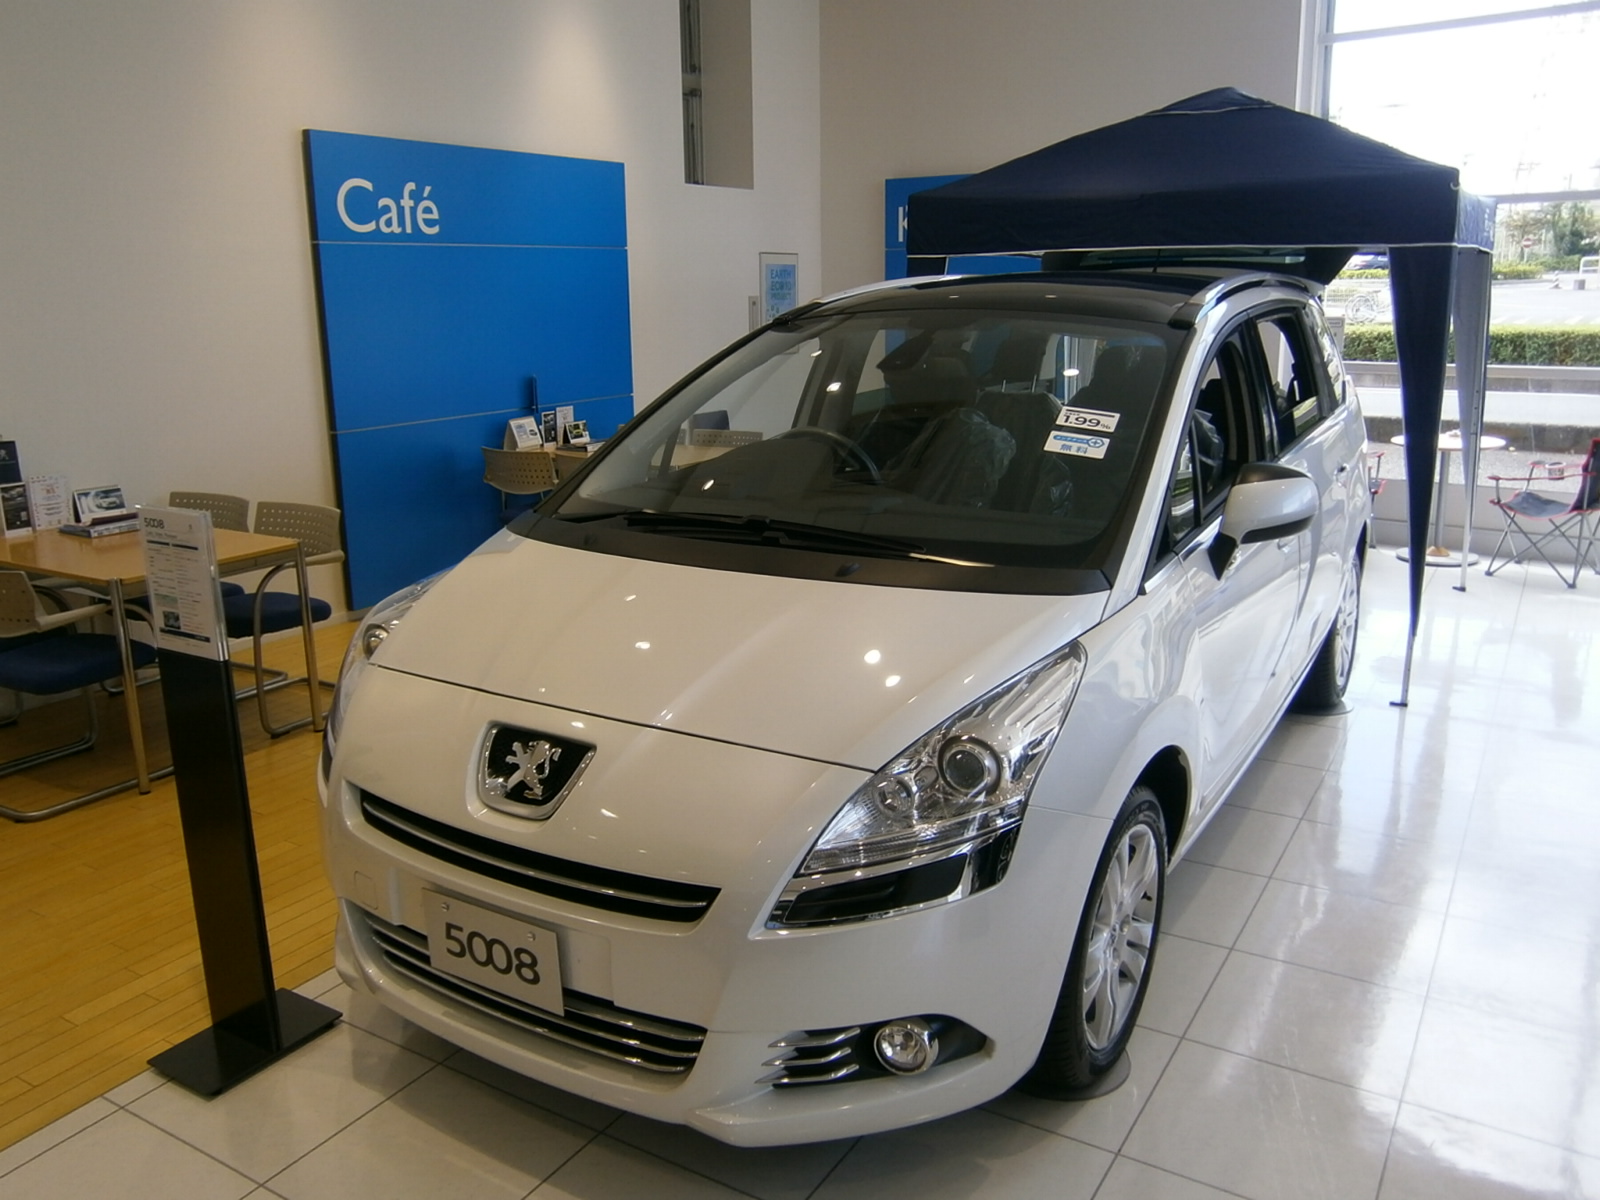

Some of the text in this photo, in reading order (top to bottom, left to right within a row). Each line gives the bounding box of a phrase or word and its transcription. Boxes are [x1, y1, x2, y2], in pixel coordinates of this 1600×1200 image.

[336, 177, 441, 235] Café
[770, 269, 792, 280] EARTH
[144, 517, 165, 529] 5008
[444, 921, 541, 986] 5008
